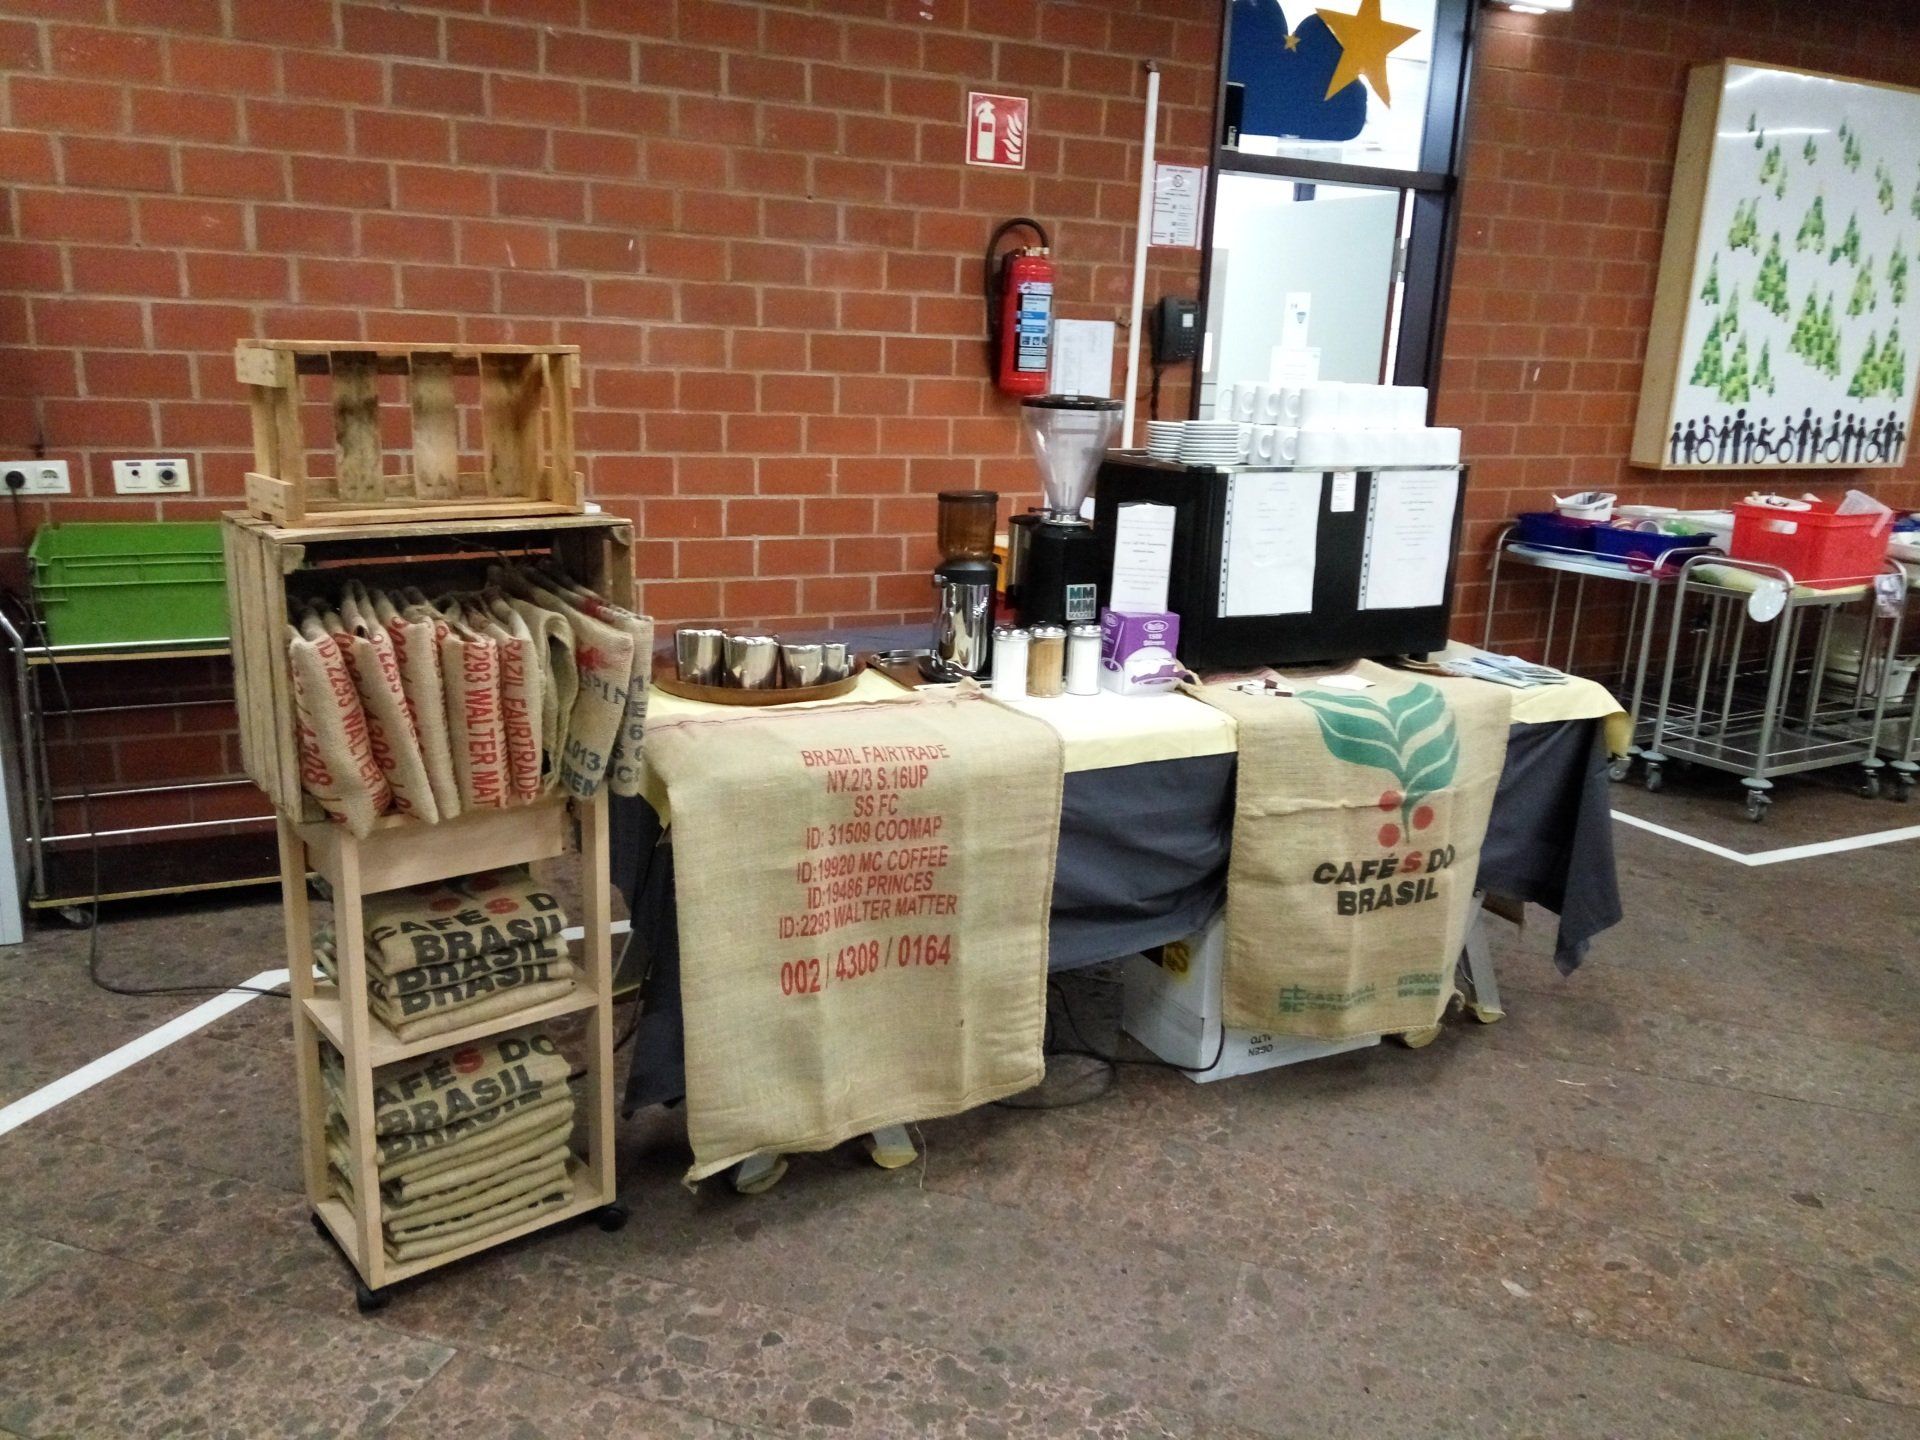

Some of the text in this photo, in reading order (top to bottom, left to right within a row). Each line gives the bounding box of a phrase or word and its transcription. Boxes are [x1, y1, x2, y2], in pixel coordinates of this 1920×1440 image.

[503, 638, 524, 687] RAZIL
[465, 687, 498, 766] WALTER
[342, 706, 382, 788] WALTER
[504, 699, 539, 800] FAIRTRADE
[801, 744, 950, 767] BRAZIL FAIRTRADE
[827, 765, 929, 793] NY.2/3 S.16UP
[853, 793, 899, 817] SS FC
[806, 816, 943, 850] ID: 31509 COOMAP
[797, 845, 949, 884] ID:19920 MC COFFEE
[1425, 844, 1456, 874] DO
[807, 871, 934, 909] ID:19486 PRINCES
[1337, 877, 1439, 916] BRASIL
[779, 894, 958, 939] ID:2293 WALTER MATTER
[781, 958, 821, 996] 002
[835, 940, 879, 982] 4308
[898, 934, 951, 968] 0164
[498, 1034, 559, 1063] DO
[378, 1064, 543, 1136] BRASIL
